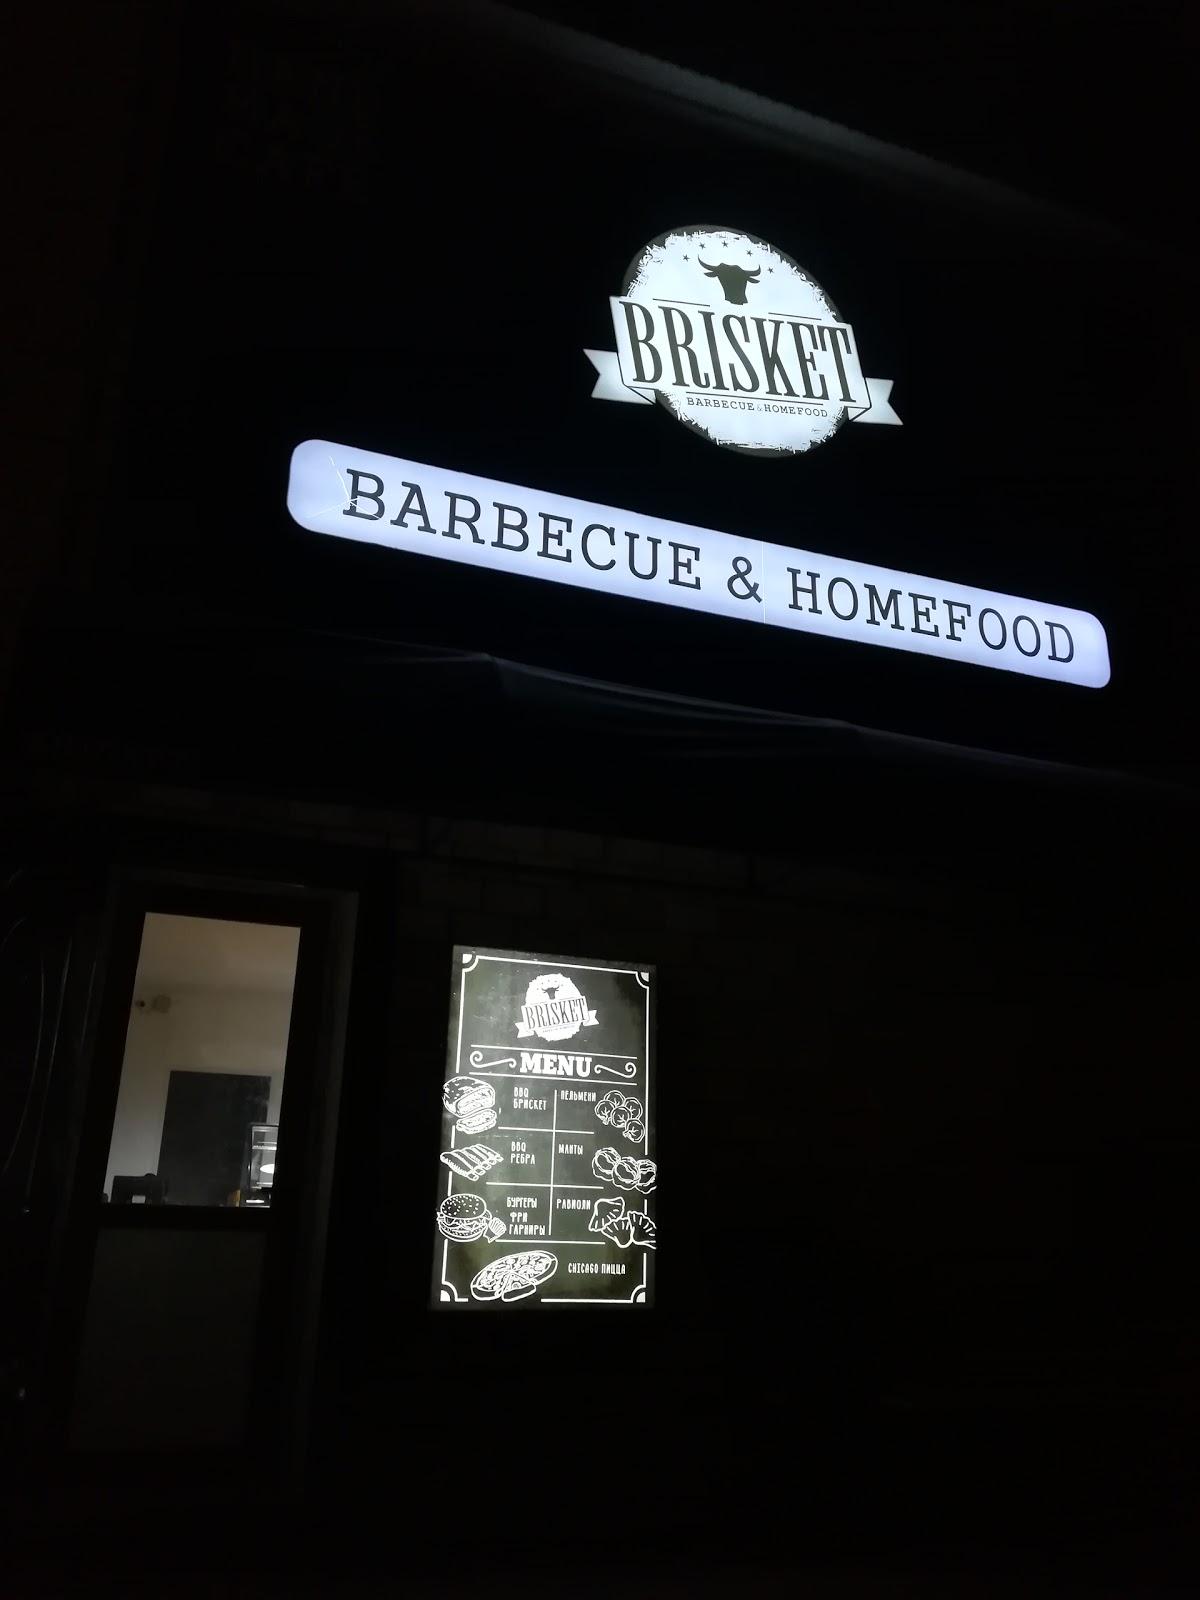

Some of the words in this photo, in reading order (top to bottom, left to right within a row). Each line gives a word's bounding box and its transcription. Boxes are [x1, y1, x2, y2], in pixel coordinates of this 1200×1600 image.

[619, 301, 856, 402] BRISKET
[342, 468, 701, 589] BARBECUE
[727, 556, 762, 603] &
[786, 567, 1075, 664] HOMEFOOD
[525, 998, 587, 1029] BRISKET
[520, 1052, 592, 1077] MENU
[560, 1090, 597, 1101] ПЕЛЬМЕНИ
[513, 1100, 547, 1110] БРИСКЕТ
[511, 1141, 527, 1152] BBQ
[558, 1144, 584, 1155] МАНТЫ
[510, 1154, 536, 1165] РЕБРА
[506, 1196, 538, 1209] БУРГЕРЫ
[556, 1199, 591, 1210] РАВИОЛИ
[509, 1212, 529, 1223] ФРИ
[508, 1224, 546, 1236] ГАРНИРЫ
[567, 1262, 599, 1274] CHICAGO
[602, 1263, 626, 1275] ПИЦЦА
